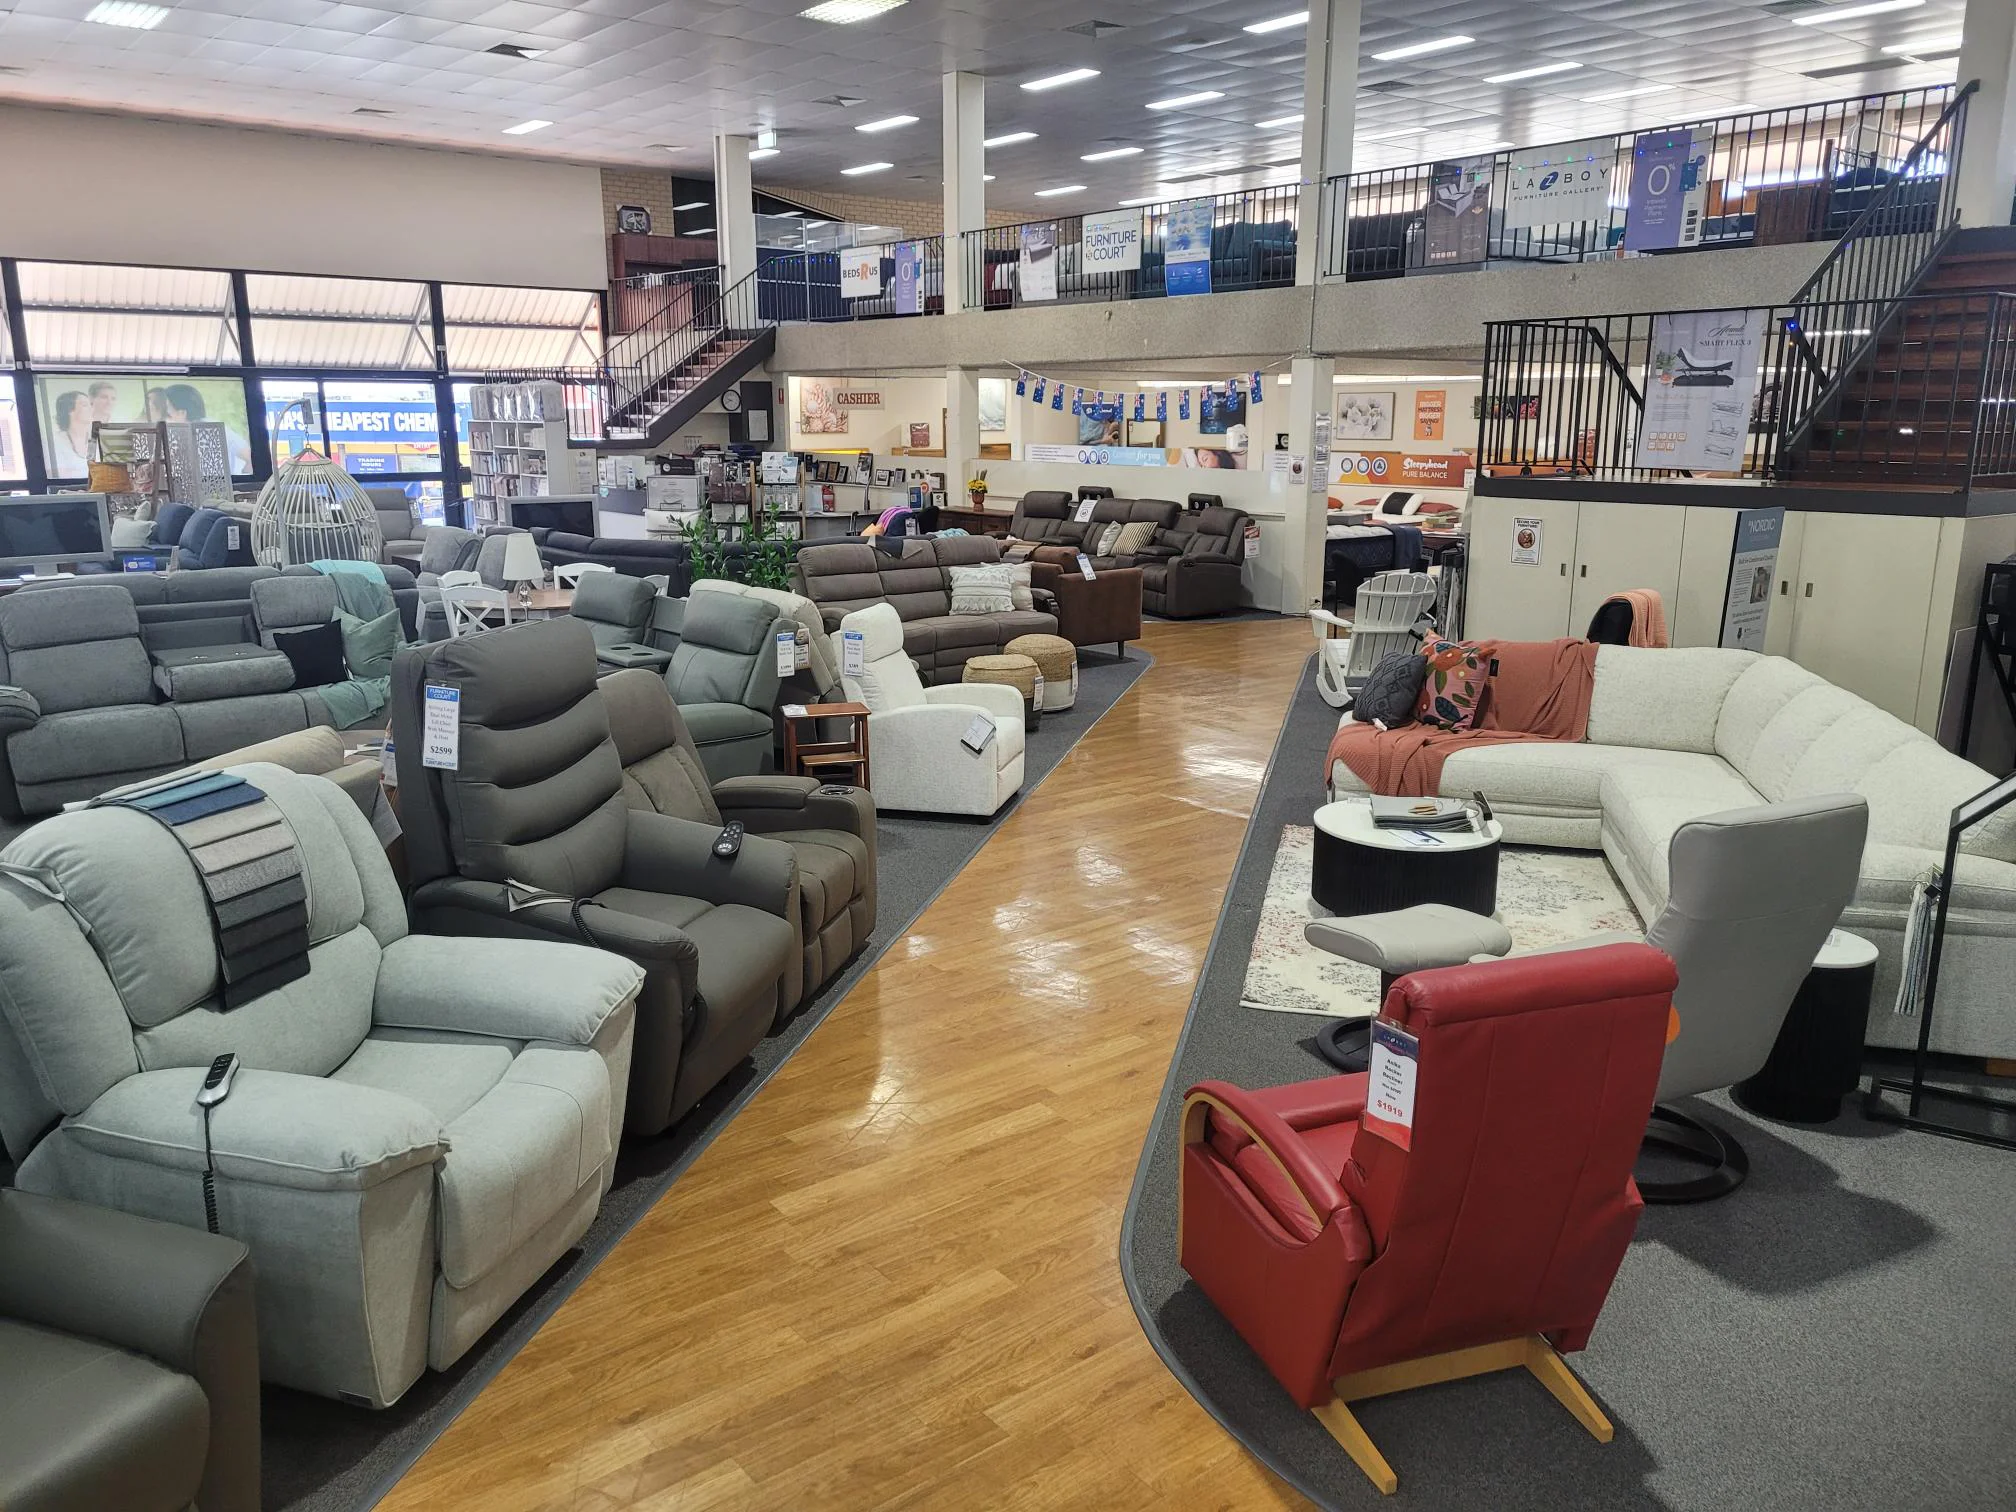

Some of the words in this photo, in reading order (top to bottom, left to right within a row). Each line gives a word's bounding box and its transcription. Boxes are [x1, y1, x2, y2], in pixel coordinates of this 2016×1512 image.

[1513, 192, 1559, 201] FURNITURE
[1086, 230, 1137, 248] FURNITURE
[1093, 245, 1127, 260] COURT
[837, 392, 880, 404] CASHIER
[328, 411, 392, 432] EAPEST
[1402, 457, 1448, 470] Sleepyhead
[1419, 471, 1448, 479] BALANCE
[430, 745, 453, 755] $2599
[1376, 1099, 1403, 1117] $1919
